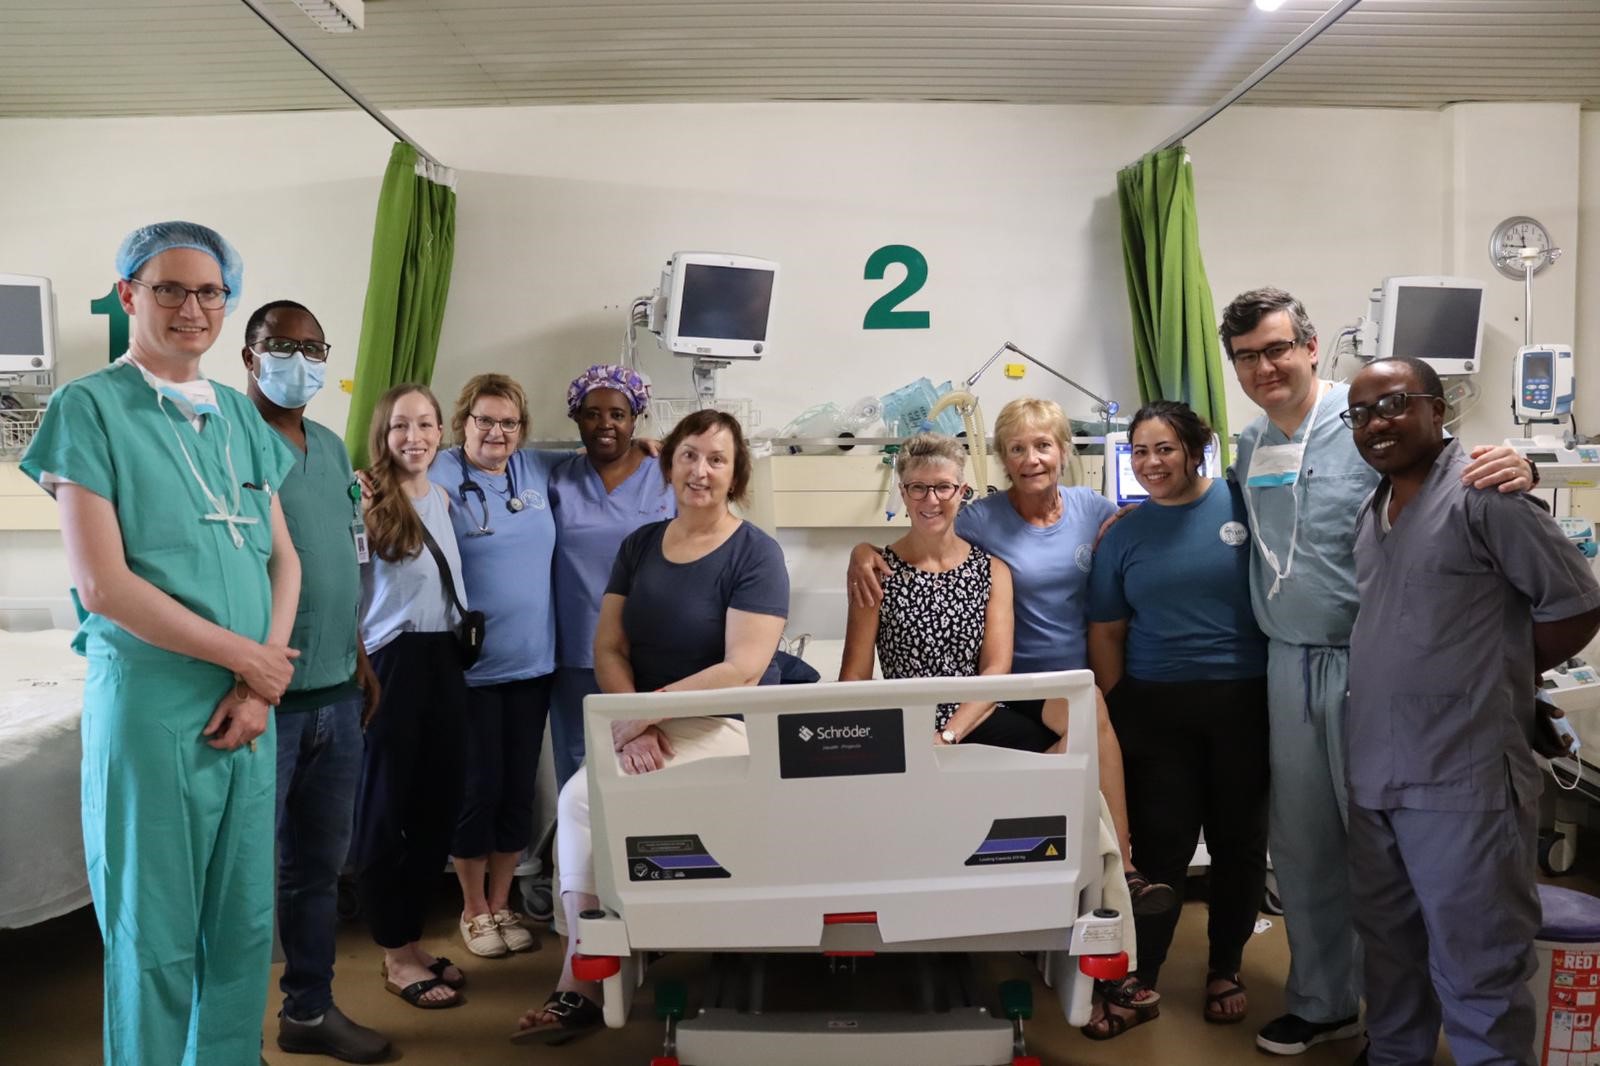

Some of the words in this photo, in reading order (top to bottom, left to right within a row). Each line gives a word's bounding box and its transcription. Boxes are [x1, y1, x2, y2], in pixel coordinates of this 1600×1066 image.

[863, 244, 930, 329] 2
[91, 283, 130, 363] 1
[817, 725, 871, 740] Schröder
[1564, 955, 1592, 969] RED
